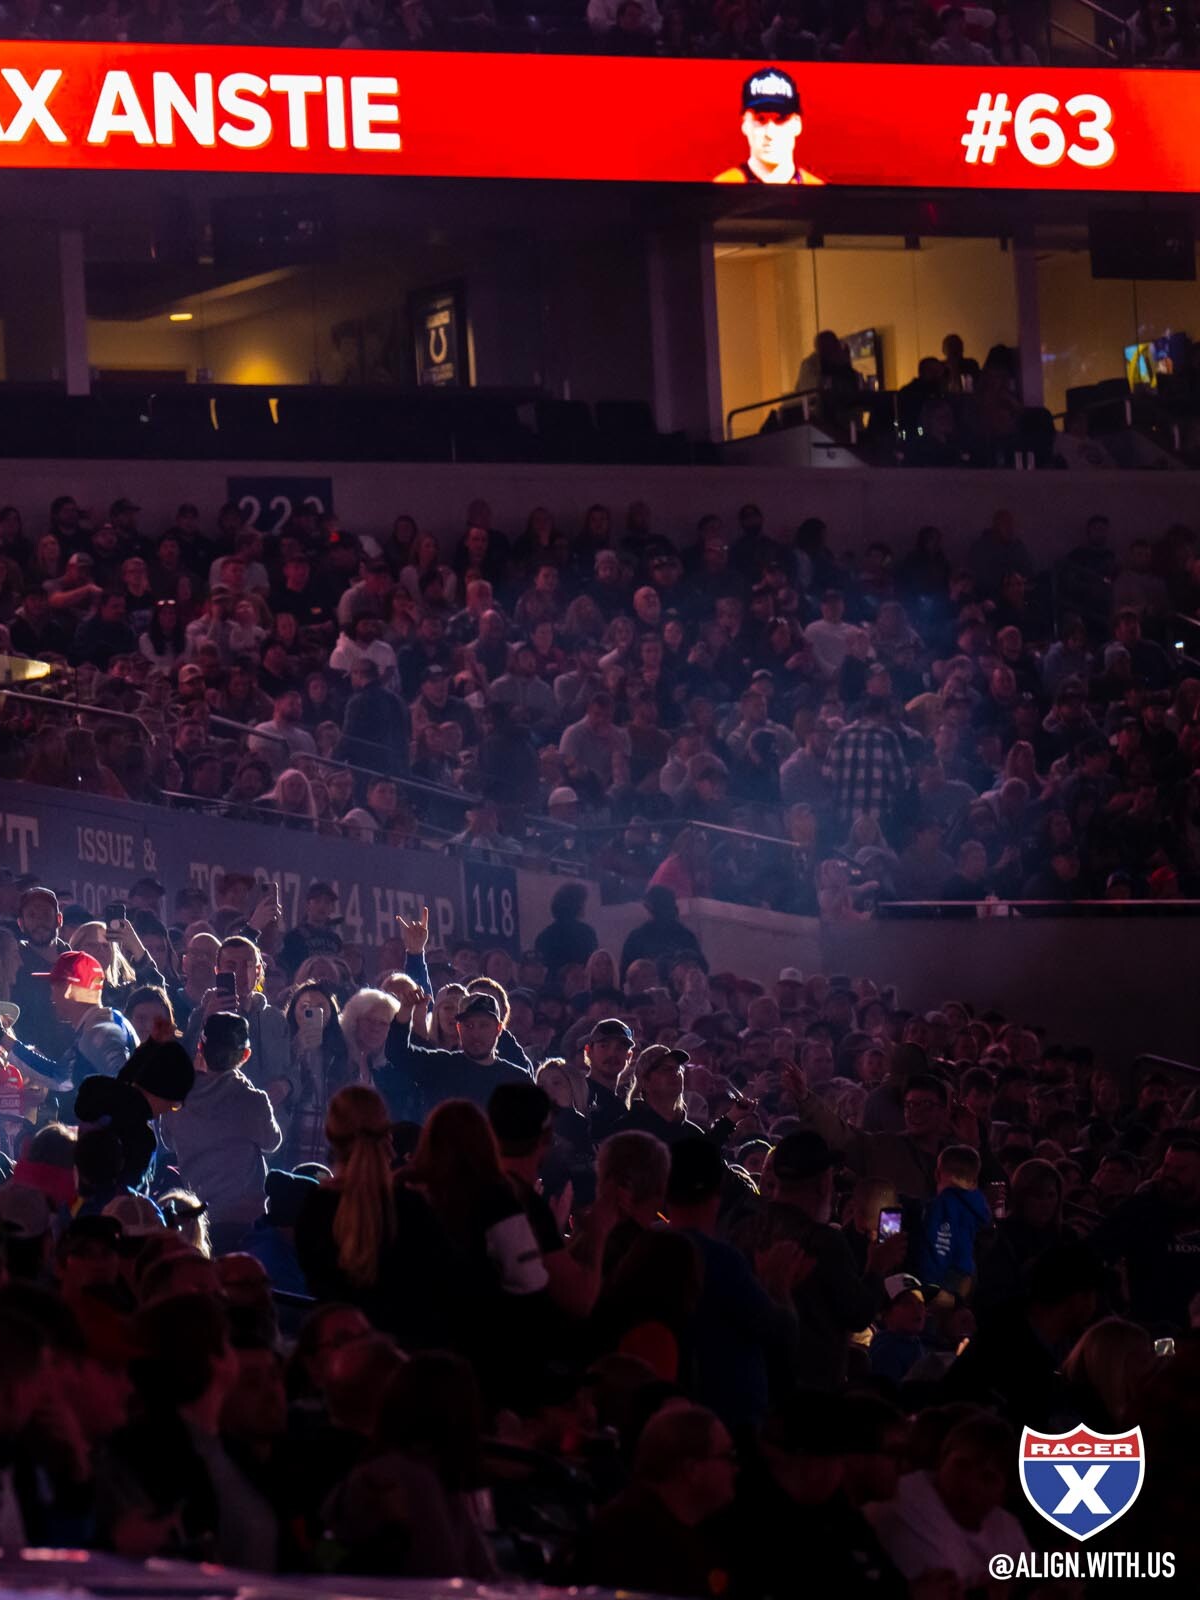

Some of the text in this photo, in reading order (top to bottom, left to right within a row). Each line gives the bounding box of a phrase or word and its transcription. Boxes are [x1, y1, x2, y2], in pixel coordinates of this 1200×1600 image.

[87, 70, 402, 151] ANSTIE
[961, 92, 1115, 167] #63
[78, 826, 157, 872] ISSUE &
[471, 884, 515, 937] 118
